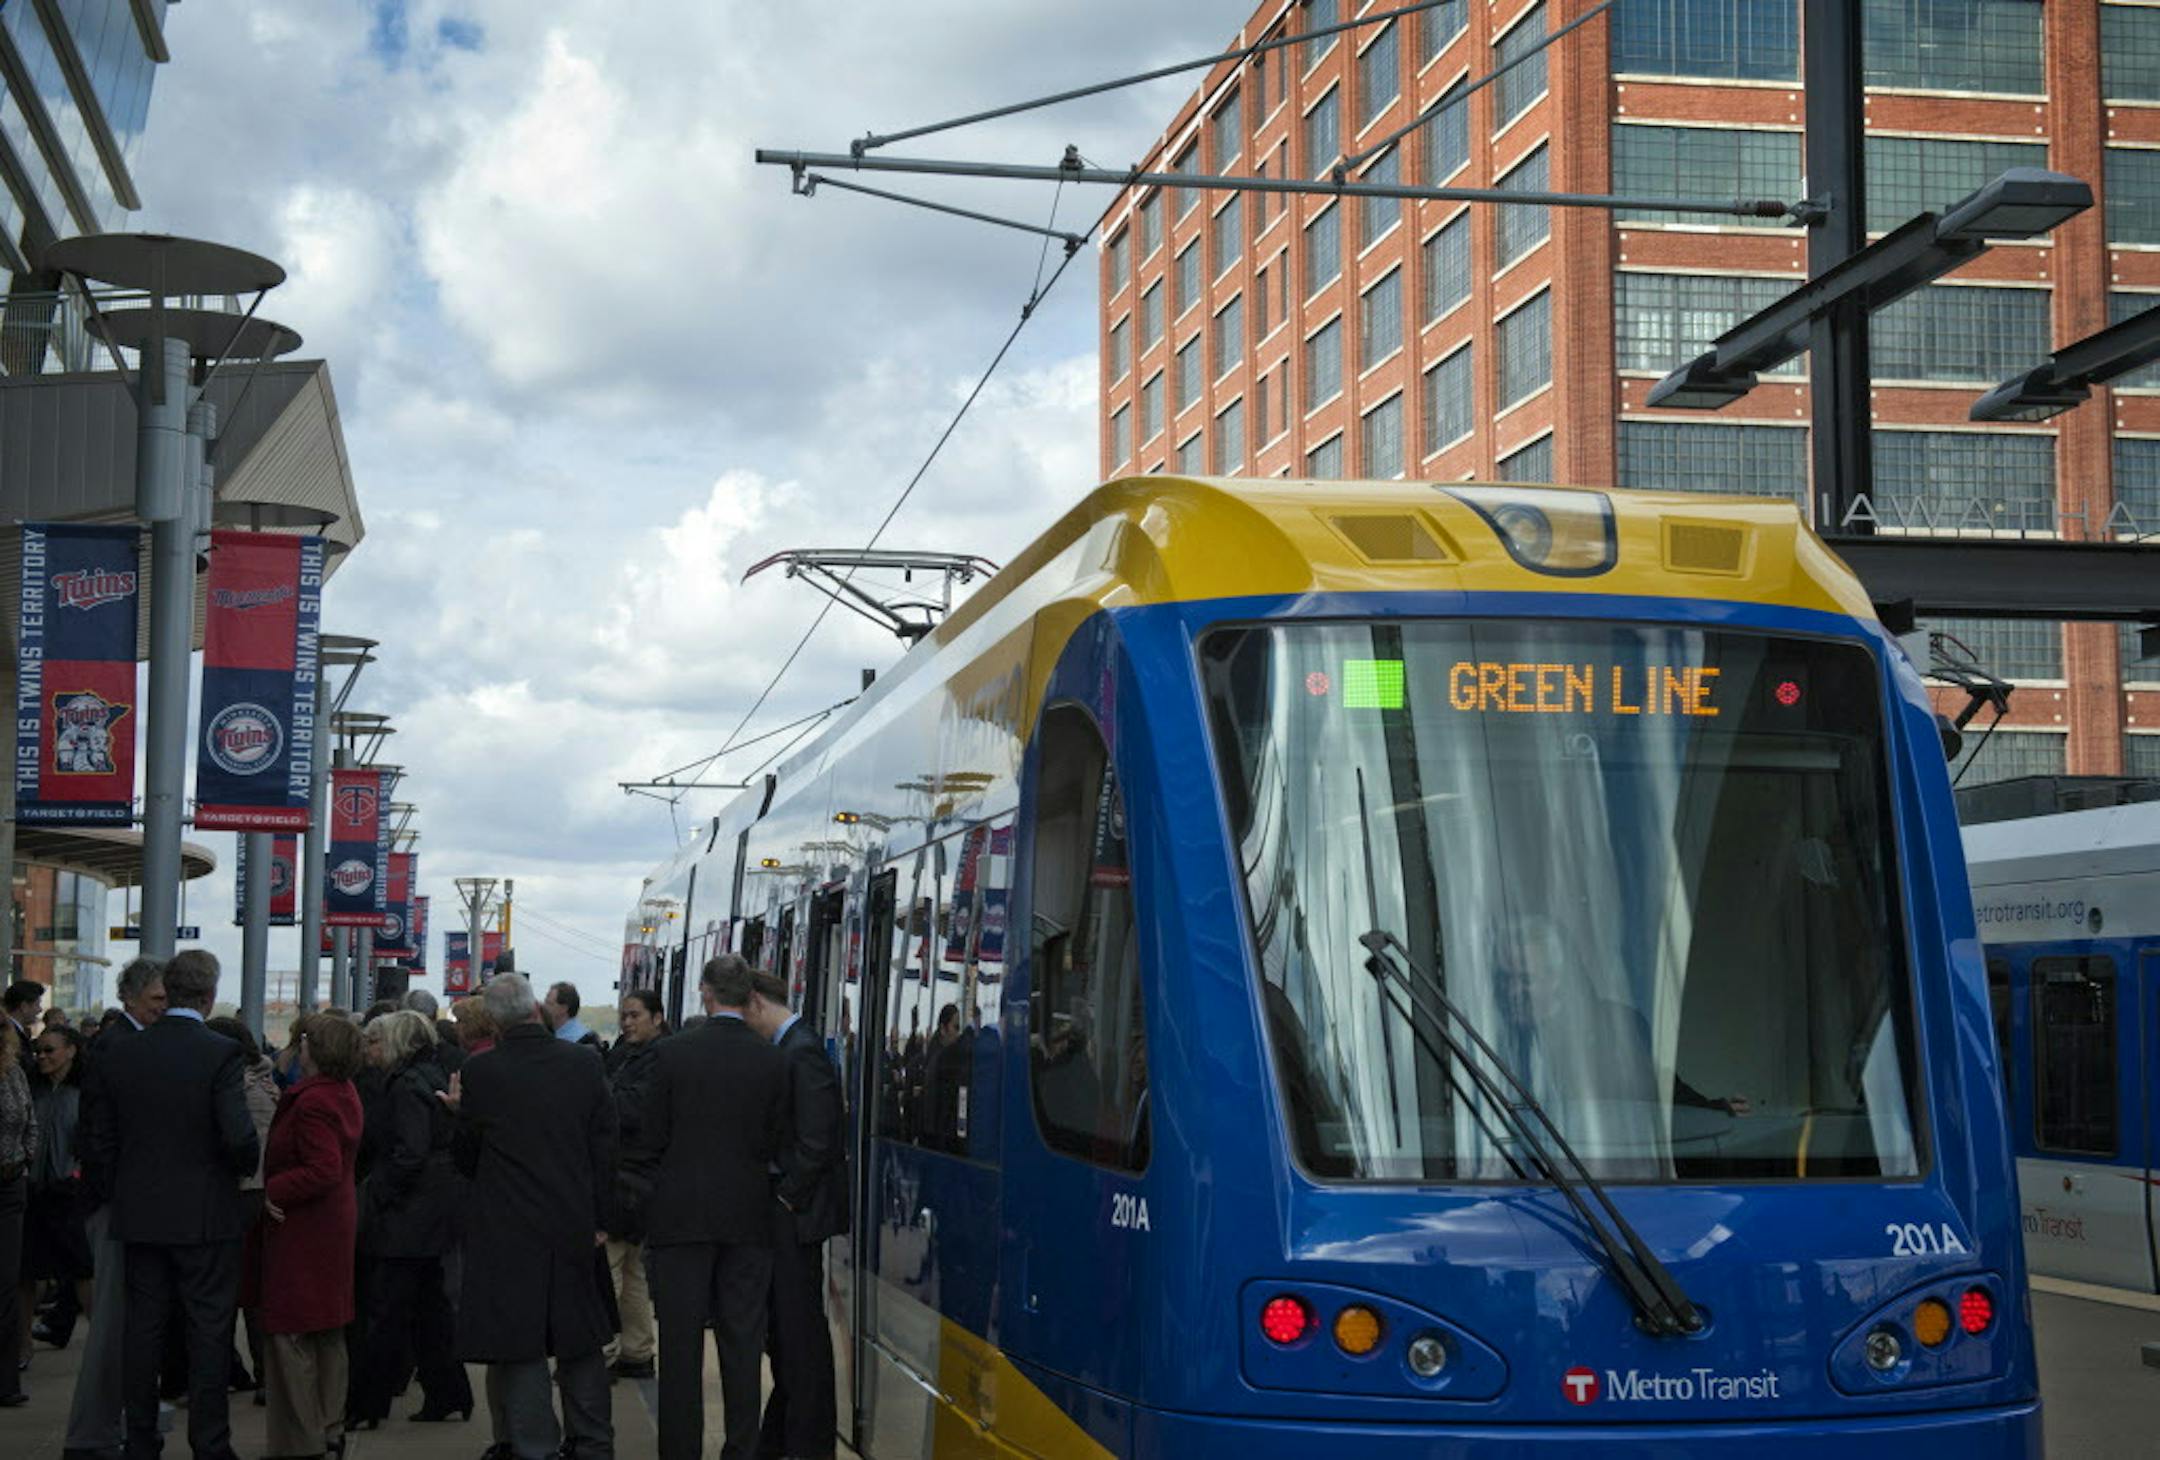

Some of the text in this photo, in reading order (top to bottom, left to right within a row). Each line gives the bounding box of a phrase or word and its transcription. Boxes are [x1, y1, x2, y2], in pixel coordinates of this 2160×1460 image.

[1772, 491, 2139, 534] IAWATHA
[51, 567, 137, 611] Twins
[16, 530, 46, 792] THIS IS TWINS TERRITORY
[289, 543, 323, 799] THIS IS TWINS TERRITORY
[1449, 662, 1721, 715] GREEN LINE
[216, 725, 274, 754] Twins
[23, 809, 125, 818] TARGET FIELD
[203, 813, 301, 825] TARGET FIELD
[1111, 1193, 1151, 1232] 201A
[1885, 1222, 1968, 1257] 201A
[1605, 1369, 1693, 1401] Metro
[1692, 1367, 1780, 1400] Transit
